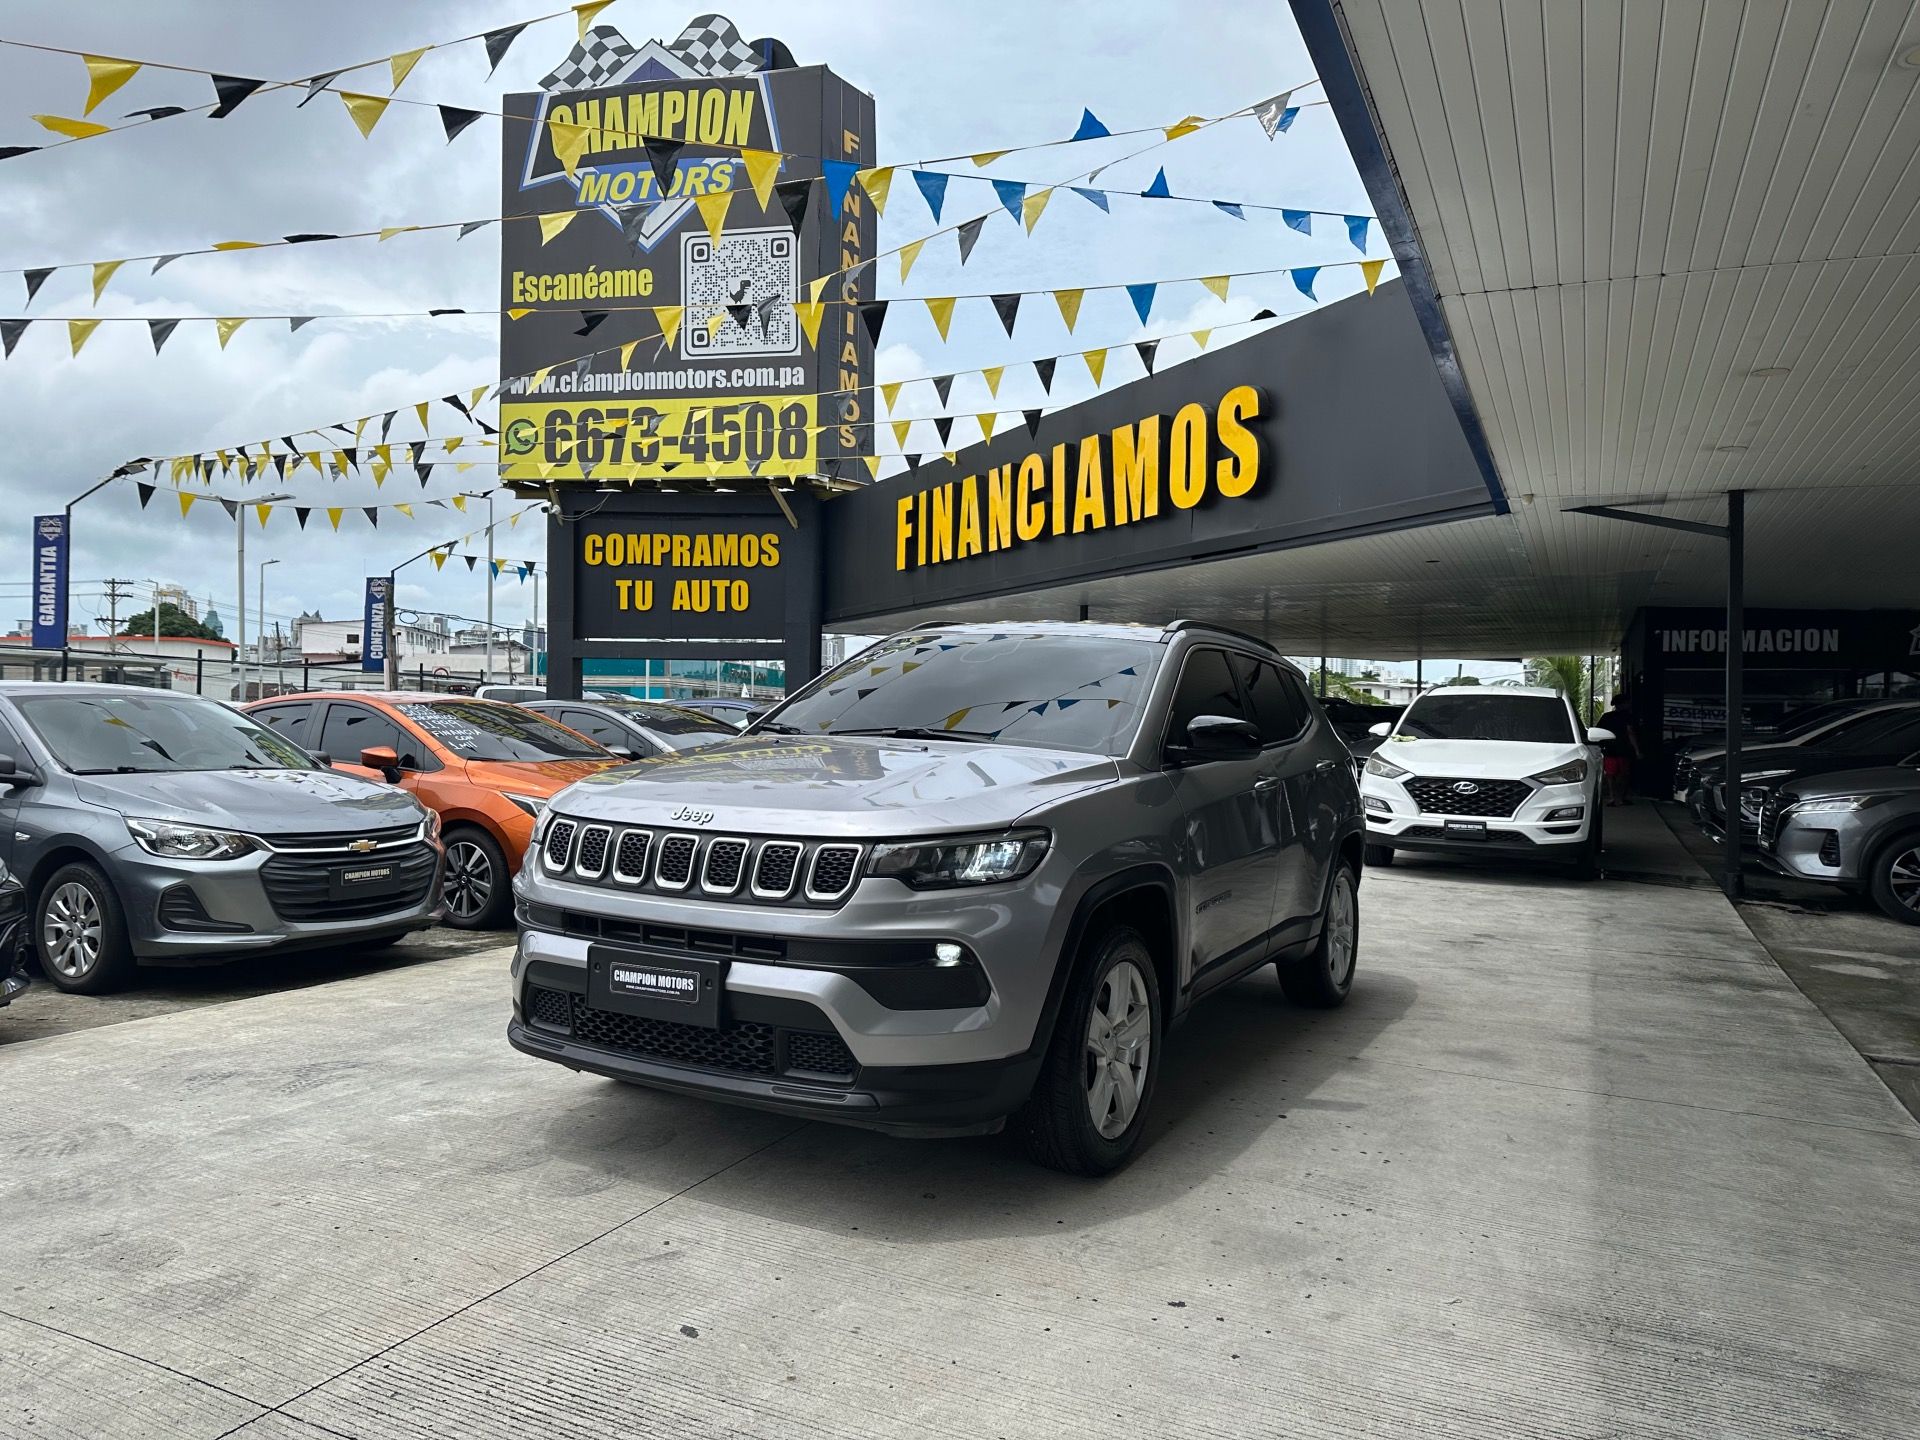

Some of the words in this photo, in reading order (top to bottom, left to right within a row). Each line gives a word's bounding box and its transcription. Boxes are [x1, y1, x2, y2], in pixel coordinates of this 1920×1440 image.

[578, 163, 733, 203] MOTORS
[512, 264, 654, 303] Escanéame
[838, 129, 861, 449] FNANCIAMOS
[509, 364, 805, 395] www.championmotors.com.pa
[544, 402, 808, 468] 6673-4508
[896, 385, 1261, 571] FINANCIAMOS
[584, 532, 780, 567] COMPRAMOS
[38, 545, 57, 626] GARANTIA
[615, 579, 654, 611] TU
[671, 579, 749, 612] AUTO
[370, 602, 385, 659] CONFIANZA
[1662, 628, 1839, 653] INFORMACION
[432, 728, 482, 738] FINANCIA
[671, 804, 714, 826] Jeep
[344, 871, 370, 880] CHAMPION
[371, 869, 389, 877] MOTORS
[614, 970, 657, 986] CHAMPION
[658, 975, 693, 990] MOTORS
